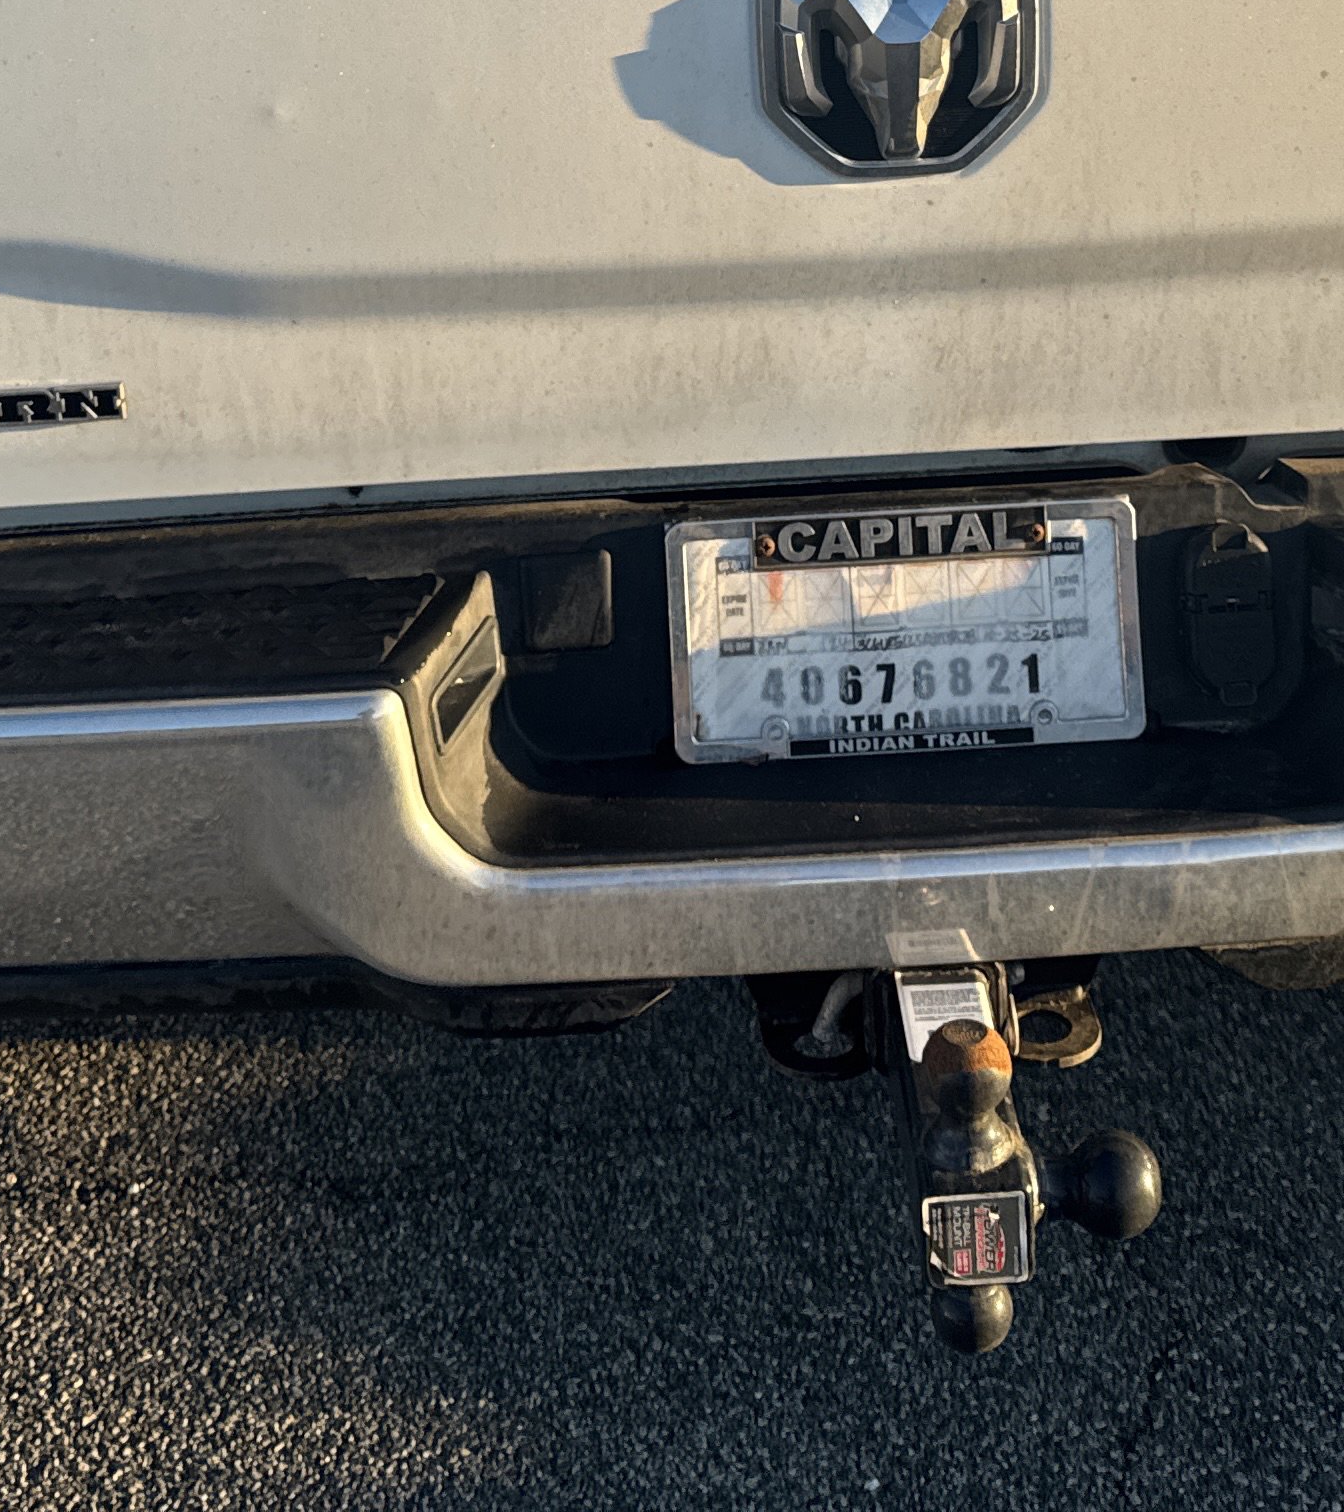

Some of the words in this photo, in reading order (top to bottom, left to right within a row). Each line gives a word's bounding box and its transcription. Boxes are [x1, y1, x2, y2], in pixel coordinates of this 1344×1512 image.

[777, 511, 1024, 563] CAPITAL
[725, 607, 745, 617] DATE
[760, 652, 1041, 708] 40676821
[796, 713, 884, 736] NORTH
[893, 704, 1023, 732] CAROLINA
[828, 735, 915, 754] INDIAN
[922, 731, 996, 748] TRAIL
